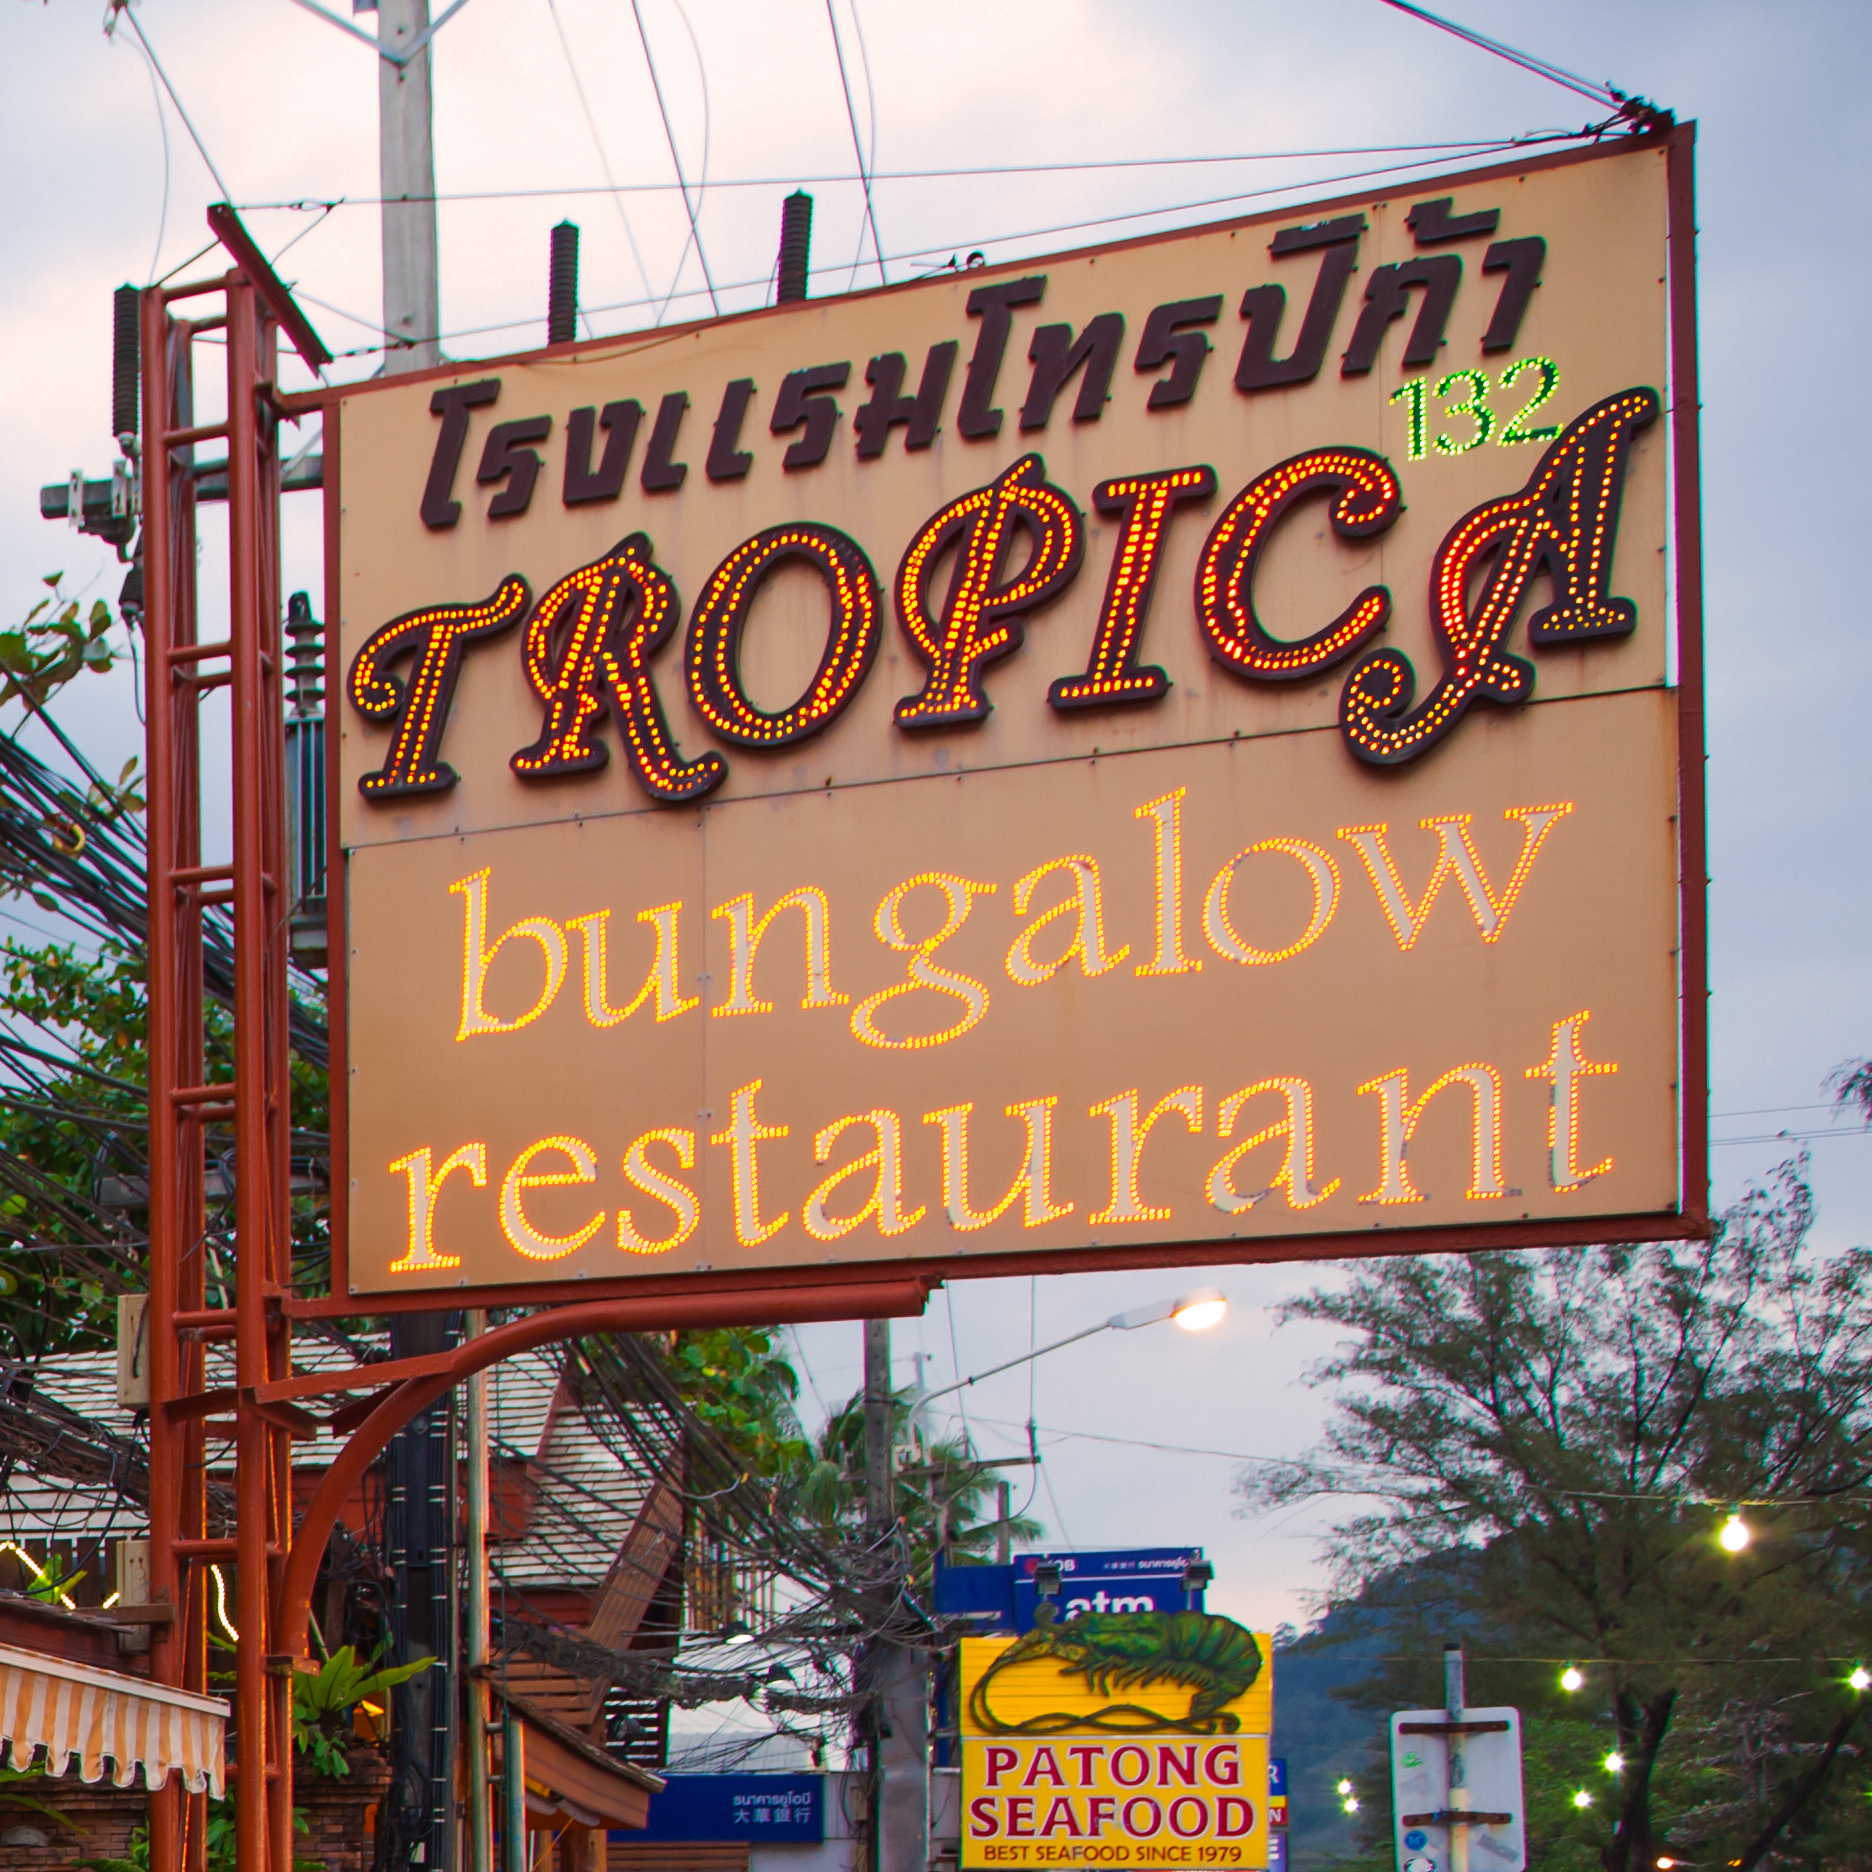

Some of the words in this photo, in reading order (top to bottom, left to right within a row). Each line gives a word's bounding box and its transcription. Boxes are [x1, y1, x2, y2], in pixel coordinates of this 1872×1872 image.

[1388, 356, 1564, 462] 132
[347, 384, 1661, 804] TROPICA
[448, 786, 1574, 1050] bungalow
[387, 1011, 1620, 1274] restaurant
[970, 1796, 1255, 1838] SEAFOOD
[985, 1744, 1241, 1787] PATONG
[984, 1845, 1029, 1861] BEST
[1036, 1845, 1130, 1861] SEAFOOD
[1136, 1845, 1192, 1861] SINCE
[1197, 1845, 1242, 1862] 1979
